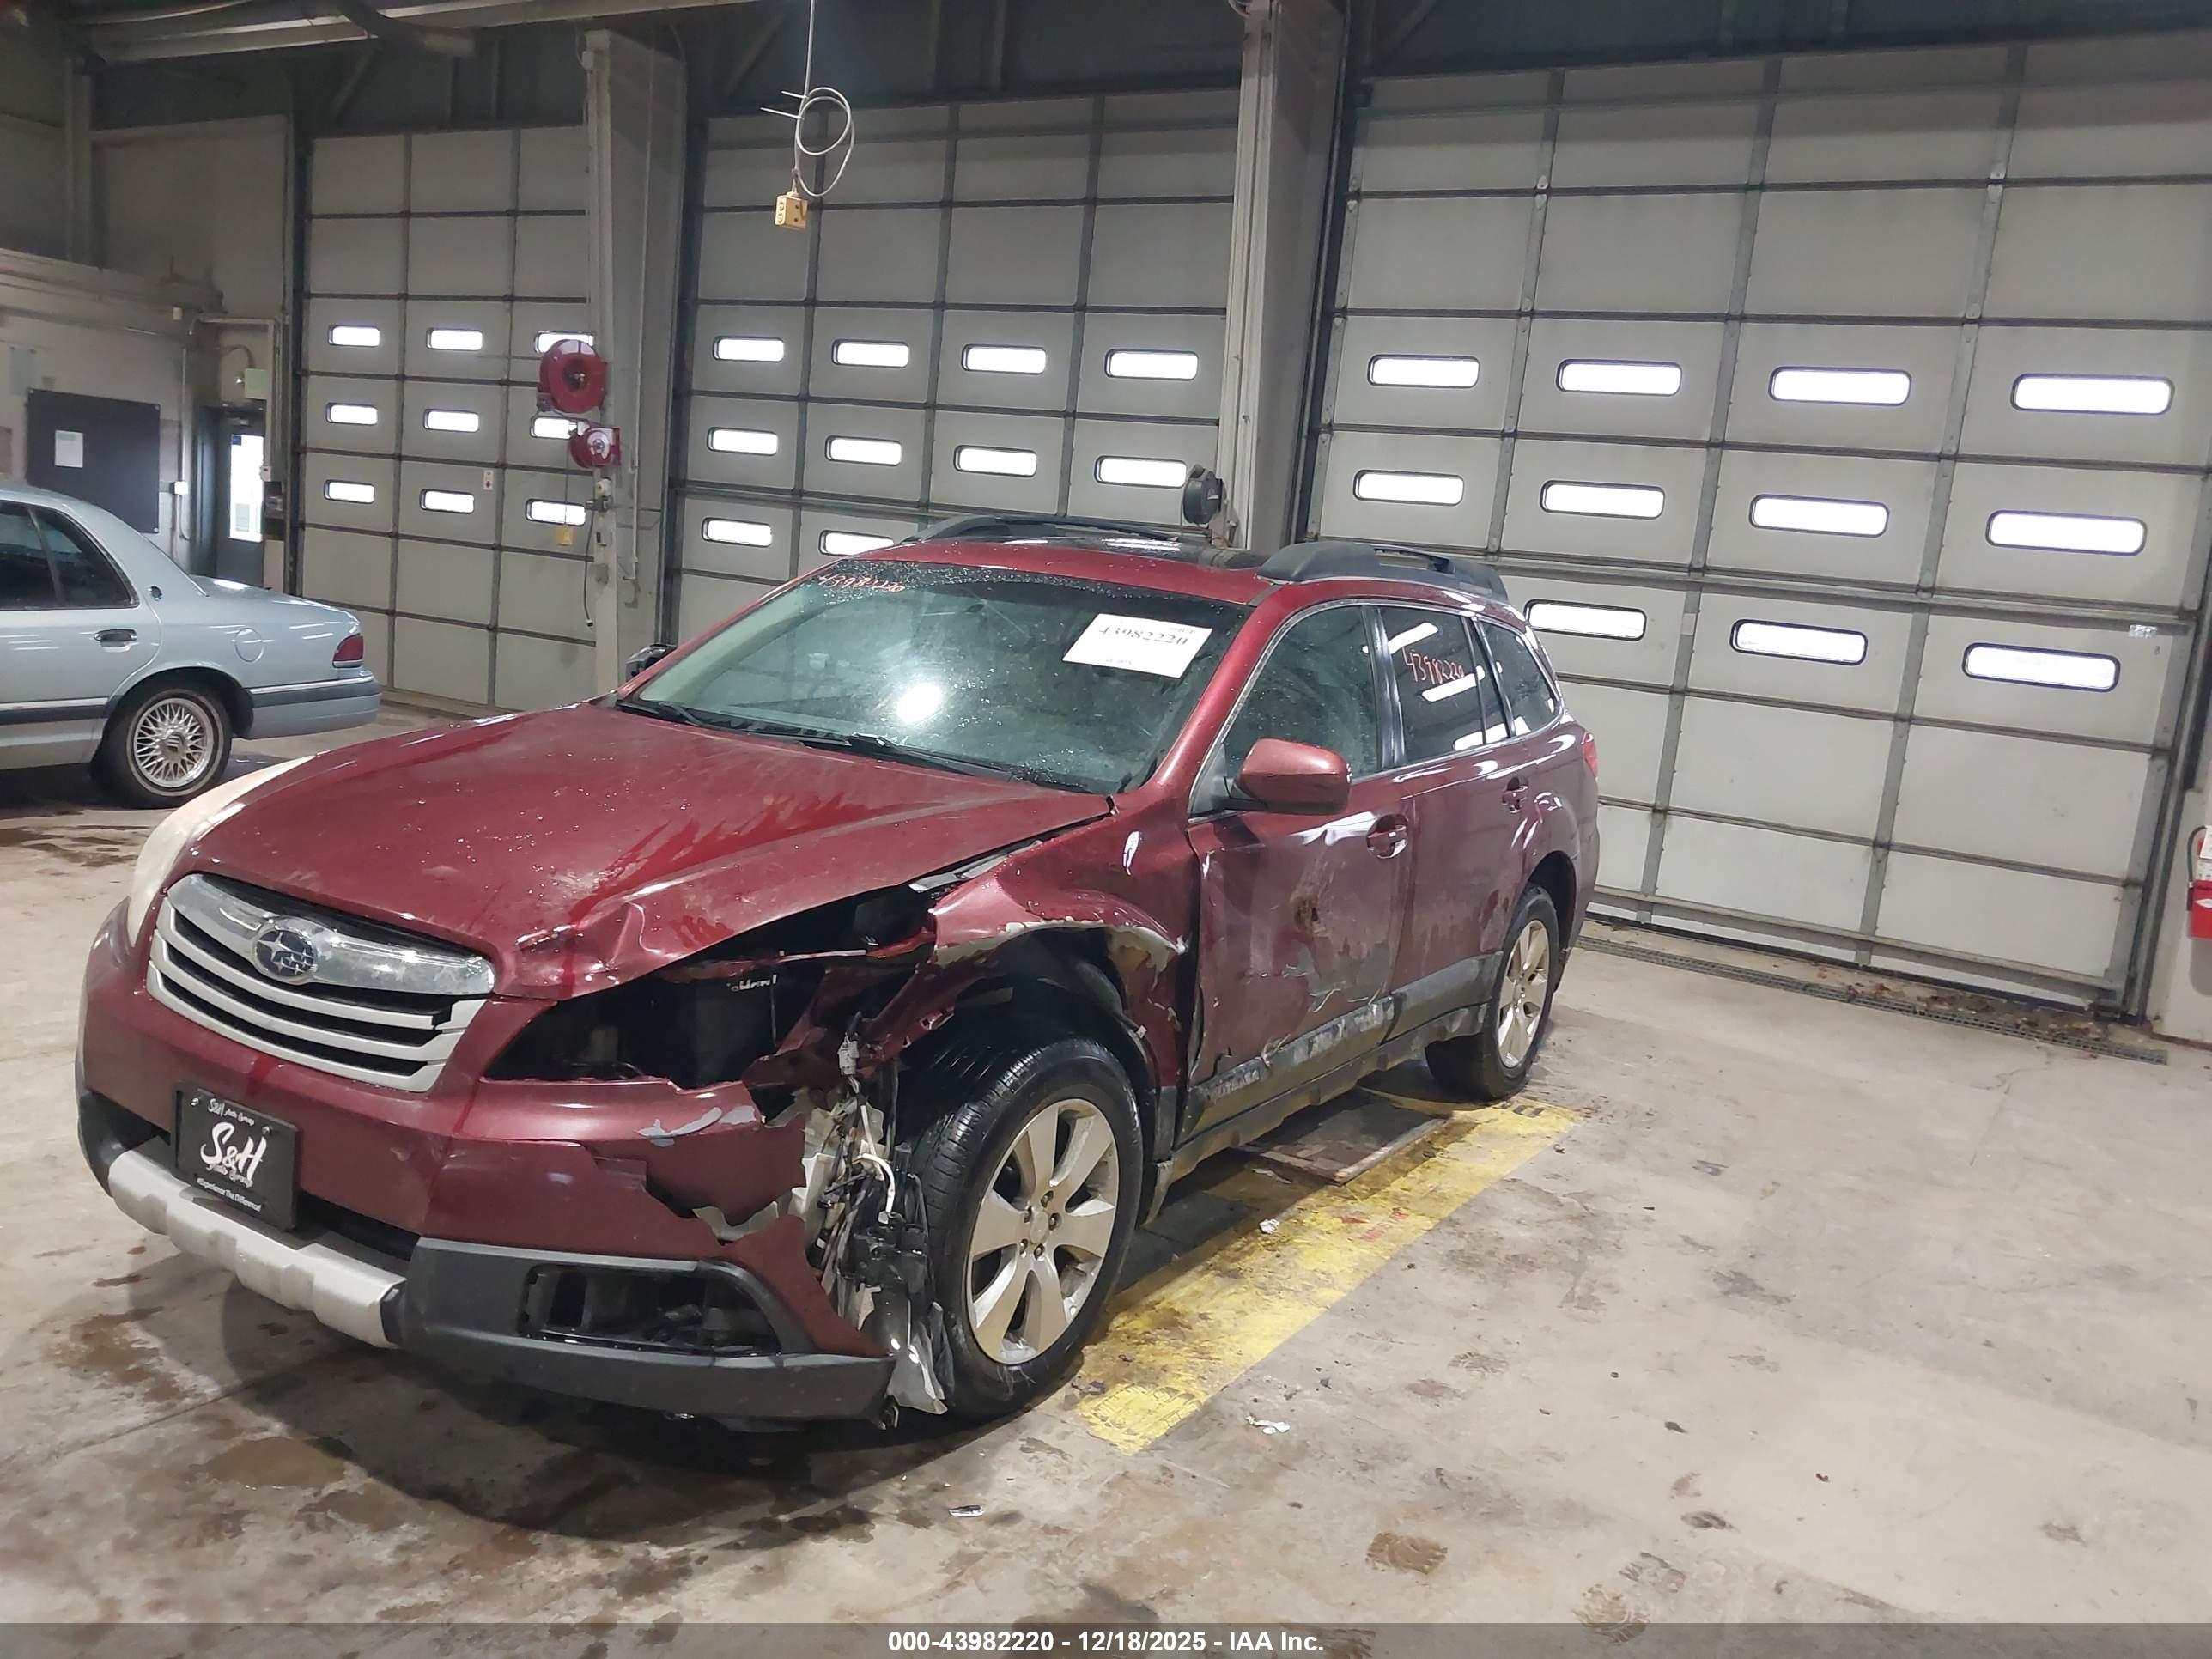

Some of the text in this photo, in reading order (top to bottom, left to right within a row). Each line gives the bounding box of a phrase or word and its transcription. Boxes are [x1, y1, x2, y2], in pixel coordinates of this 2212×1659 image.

[1099, 625, 1188, 646] 43982220
[1401, 647, 1465, 685] 43982220
[200, 1122, 267, 1181] S&H
